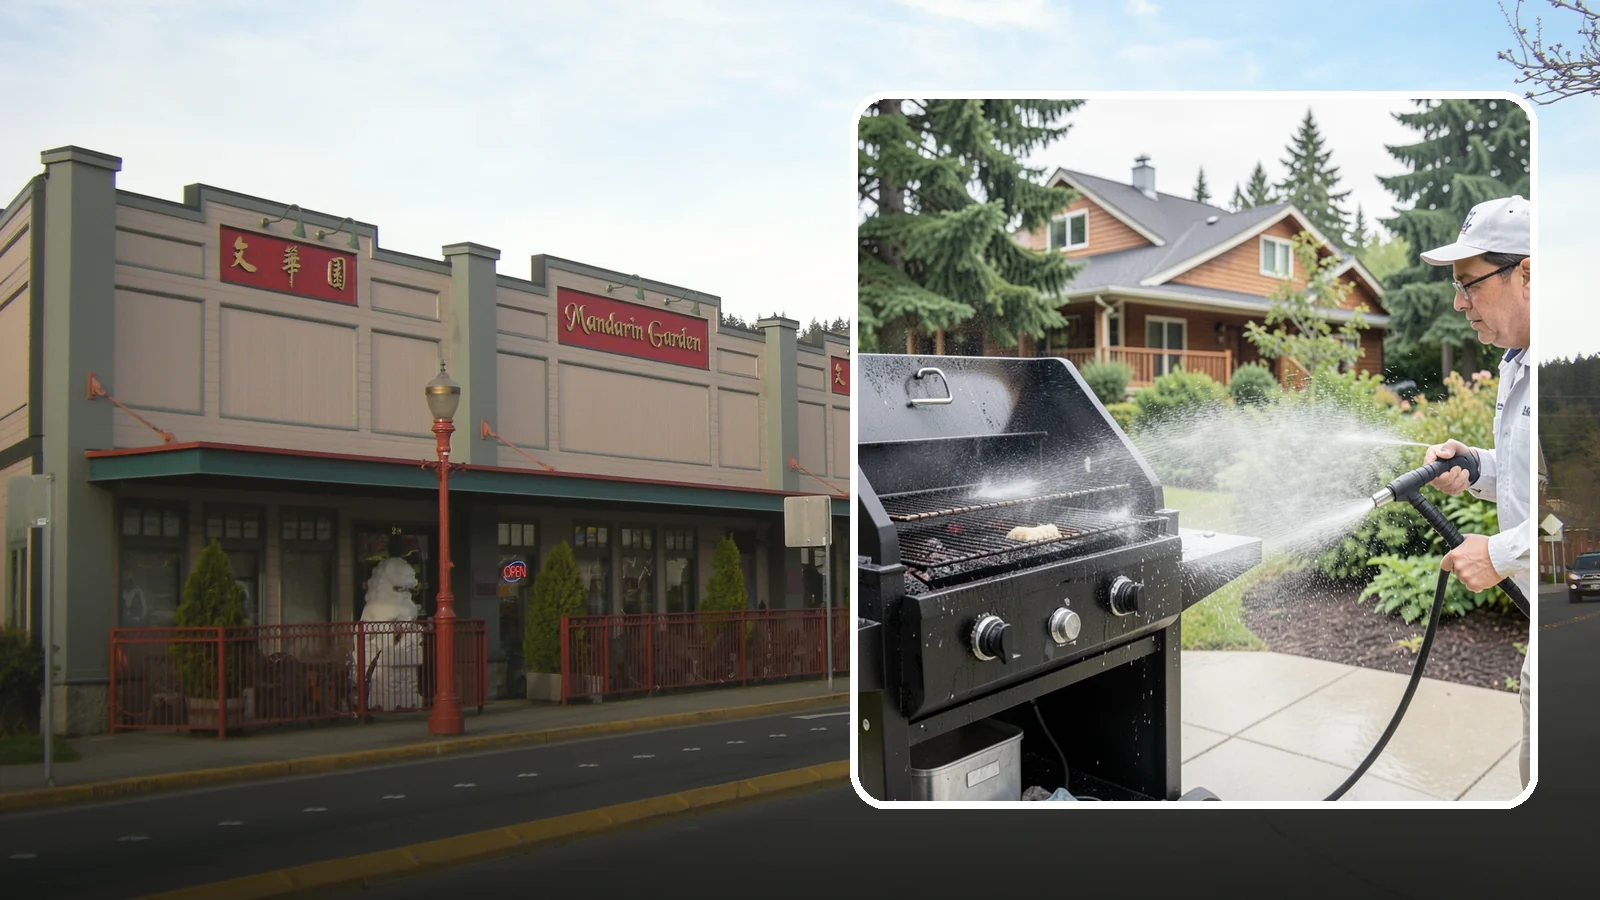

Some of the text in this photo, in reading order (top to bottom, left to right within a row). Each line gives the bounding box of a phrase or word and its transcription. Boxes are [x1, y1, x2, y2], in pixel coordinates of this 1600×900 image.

[231, 235, 346, 291] 文華園
[564, 302, 702, 352] Mandarin Garden
[503, 565, 527, 578] OPEN
